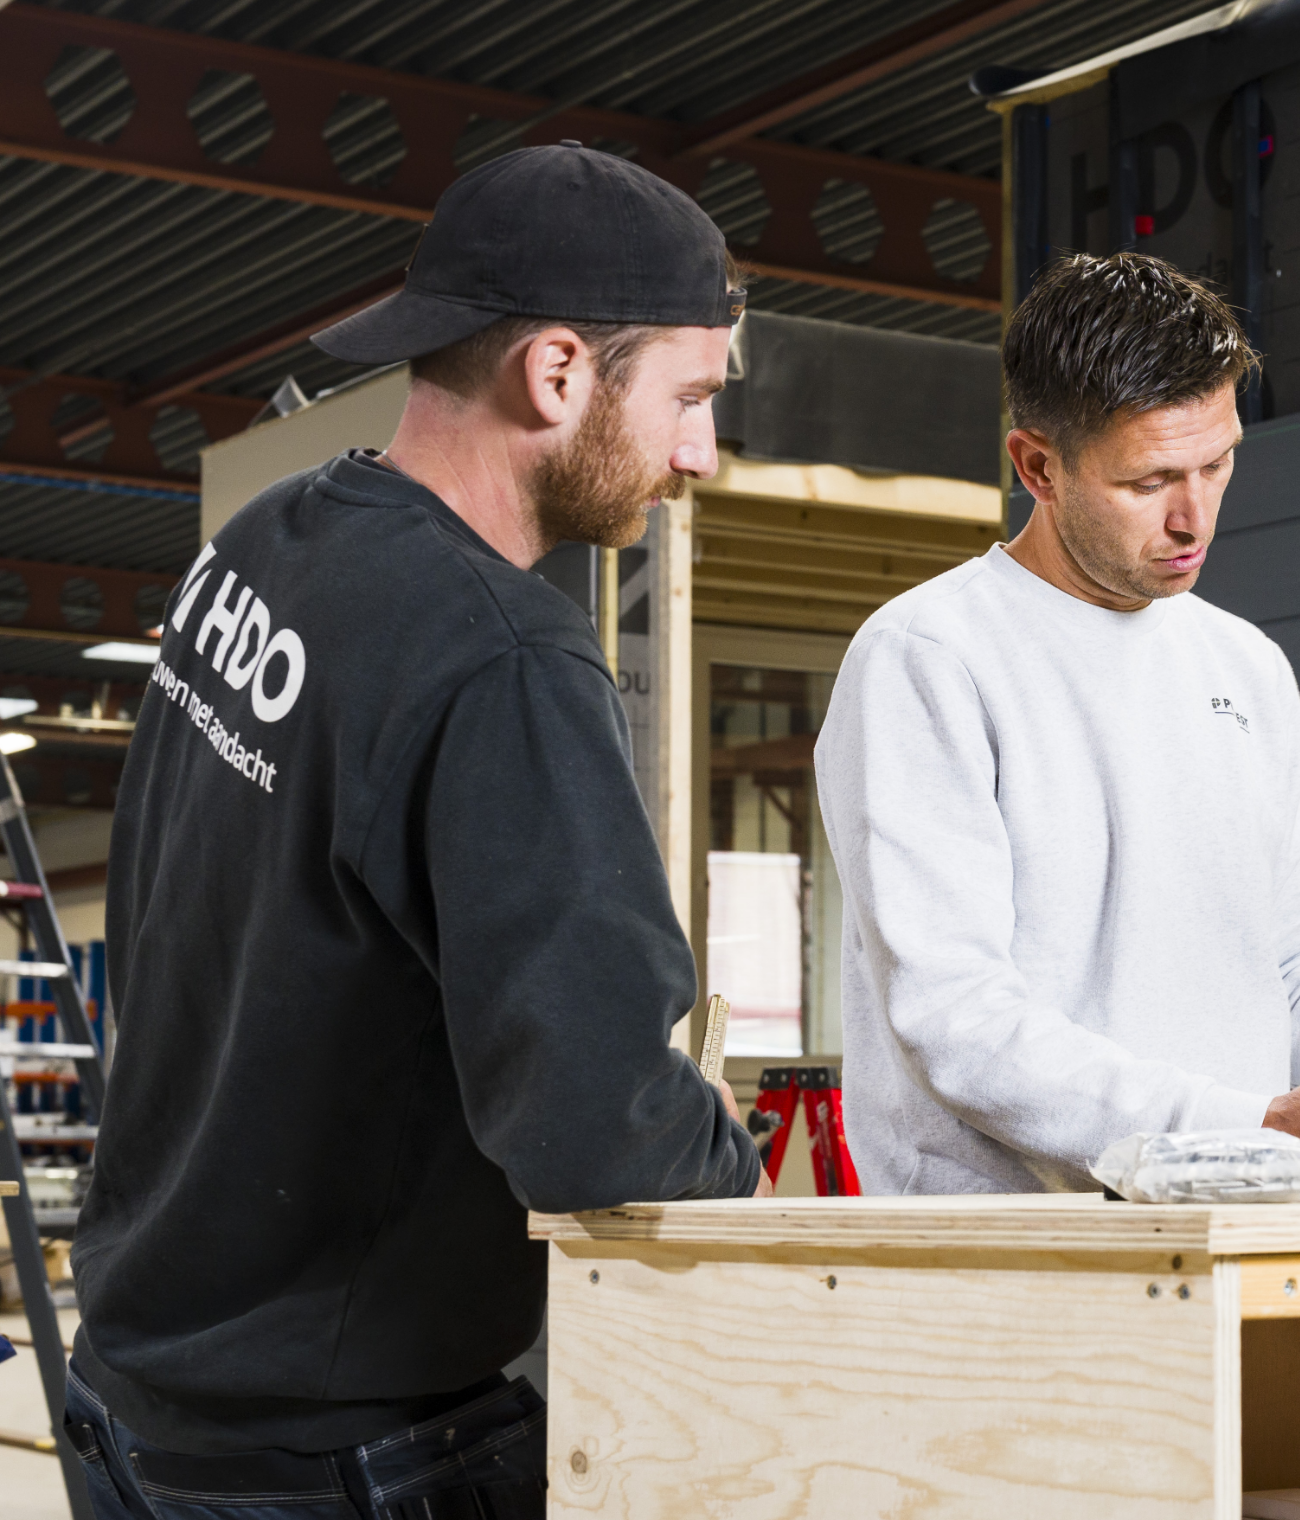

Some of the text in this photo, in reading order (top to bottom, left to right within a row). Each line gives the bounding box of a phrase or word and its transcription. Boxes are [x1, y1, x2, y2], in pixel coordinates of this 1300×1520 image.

[195, 569, 306, 723] HDO
[152, 658, 278, 793] uwen met aandacht
